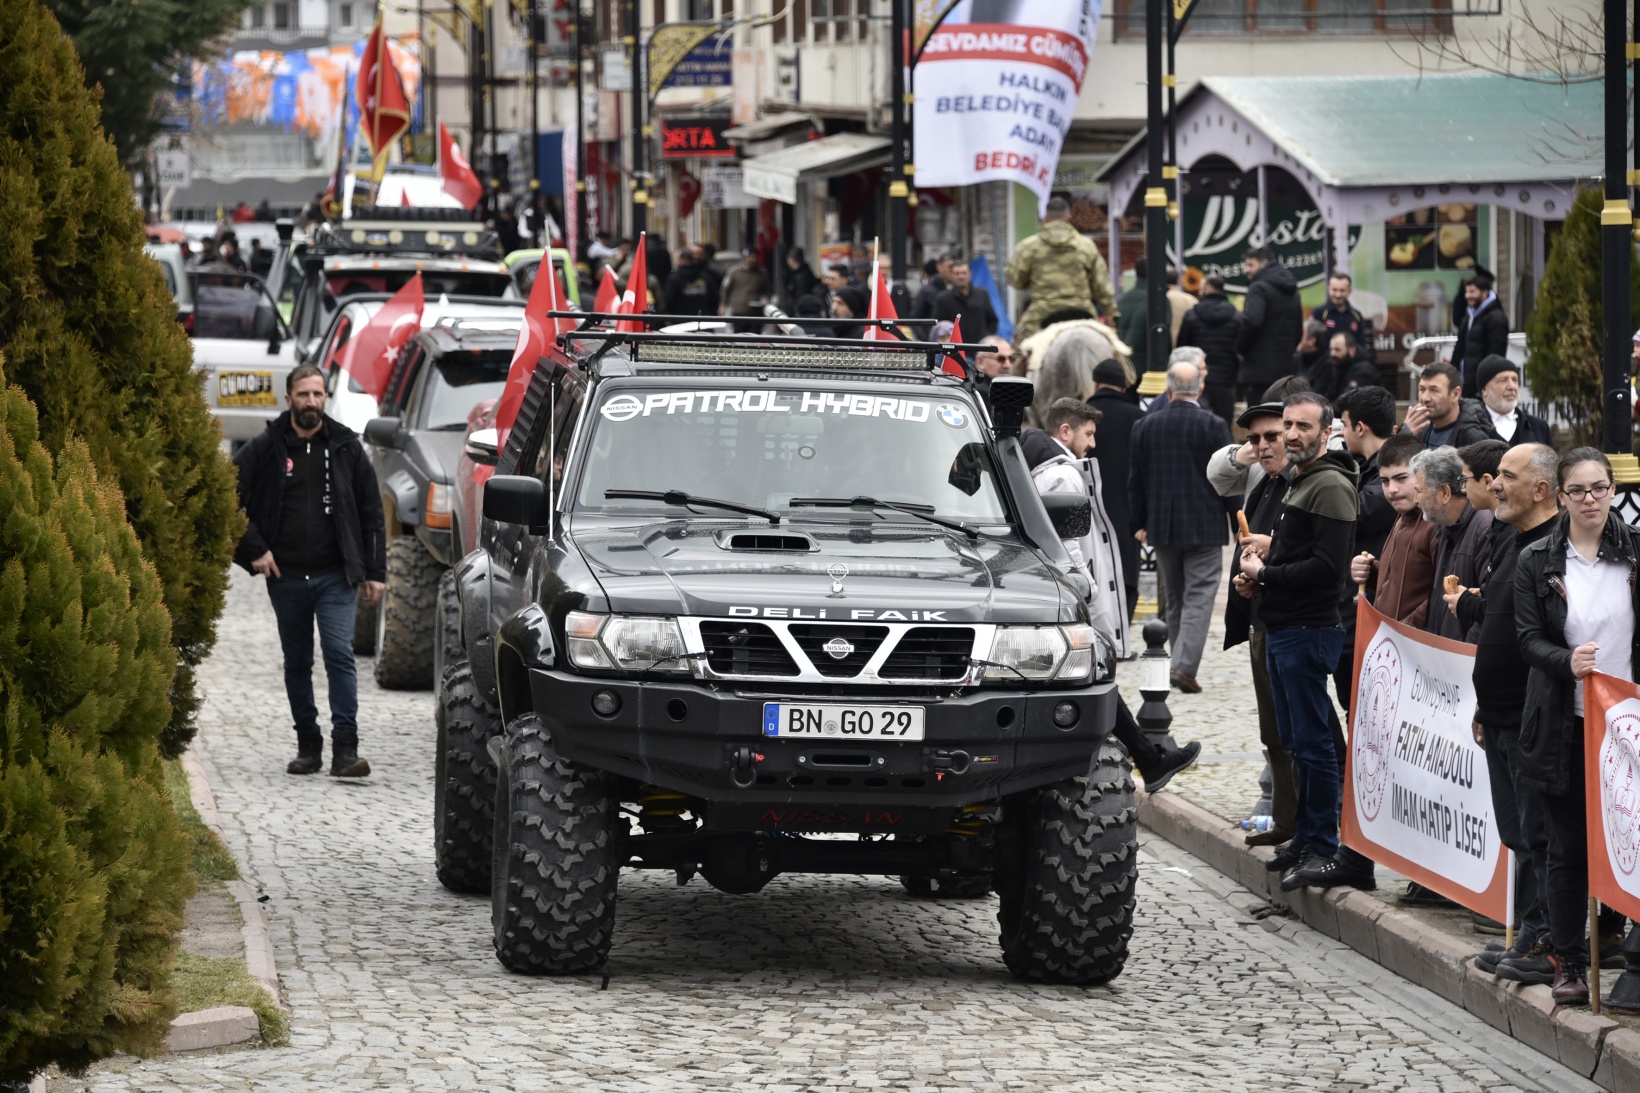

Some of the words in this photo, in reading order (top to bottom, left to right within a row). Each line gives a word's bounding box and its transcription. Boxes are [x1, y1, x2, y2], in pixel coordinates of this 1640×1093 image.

[925, 32, 1028, 54] SEVDAMIZ
[1000, 71, 1068, 105] HALKIN
[936, 94, 1043, 120] BELEDİYE
[975, 151, 1038, 177] BEDRİ
[606, 405, 639, 413] NISSAN
[642, 390, 790, 417] PATROL
[800, 391, 930, 423] HYBRID
[788, 708, 823, 733] BN
[841, 710, 874, 734] GO
[880, 711, 912, 735] 29
[1394, 717, 1430, 770] FATİH
[1425, 733, 1475, 790] ANADOLU
[761, 809, 904, 825] NISSAN
[1392, 773, 1419, 832] İMAM
[1420, 793, 1452, 846] HATİP
[1454, 801, 1488, 861] LİSESİ
